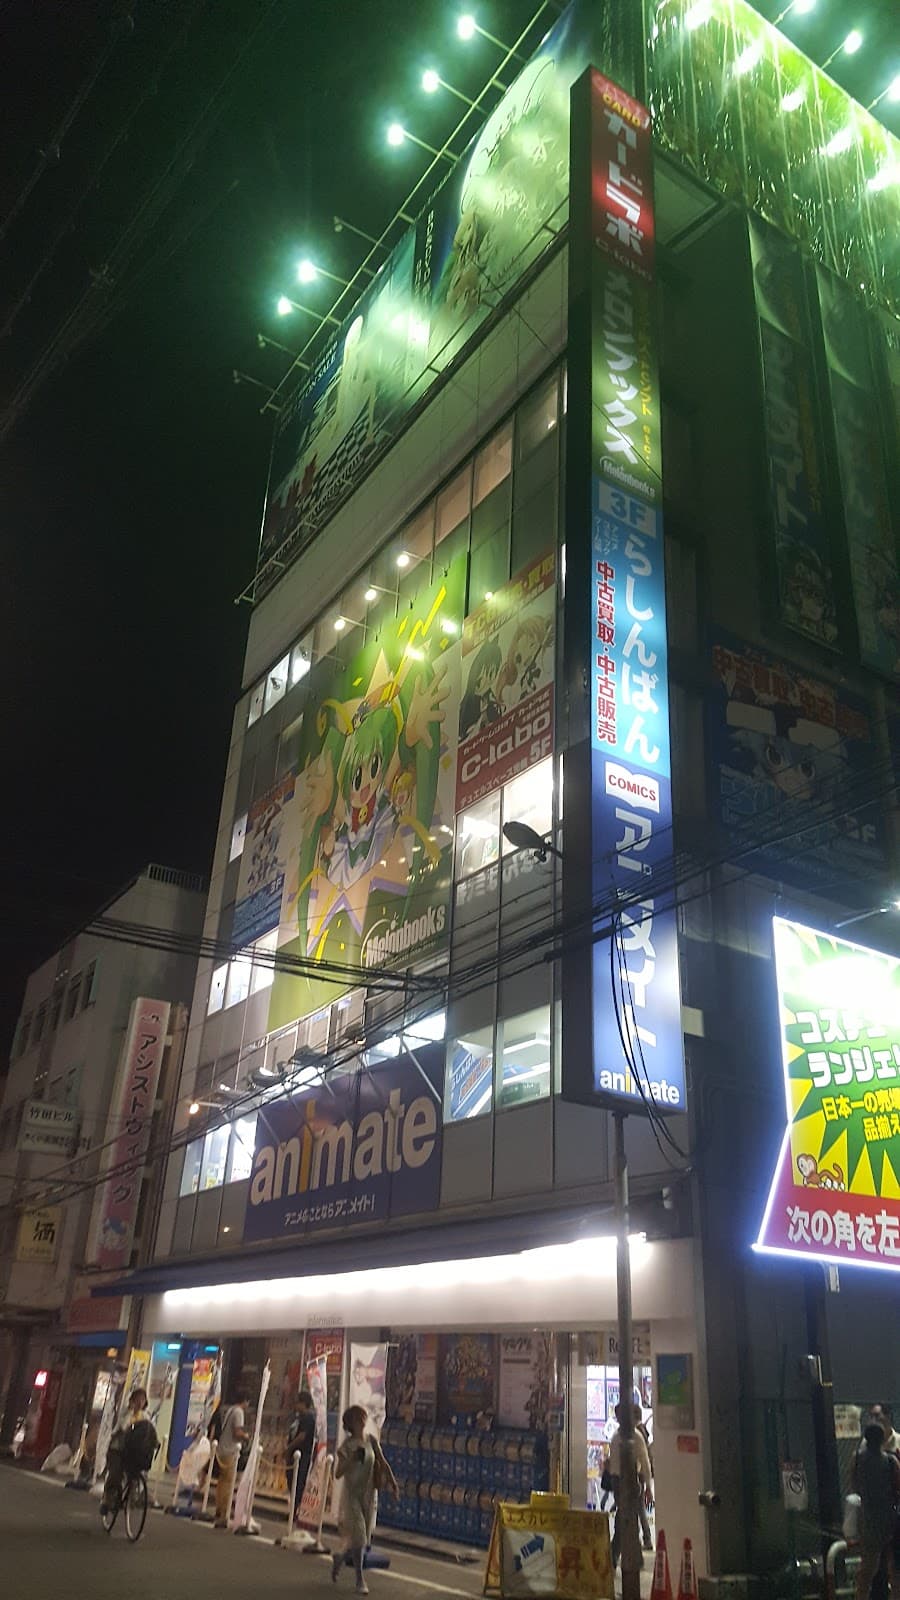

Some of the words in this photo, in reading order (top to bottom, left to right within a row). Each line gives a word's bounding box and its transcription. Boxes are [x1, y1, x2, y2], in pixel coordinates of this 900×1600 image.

[603, 108, 643, 256] カードラボ
[610, 490, 648, 527] 3F
[622, 534, 660, 764] らしんばん
[461, 710, 551, 785] C-labo
[530, 735, 552, 765] 5F
[608, 773, 657, 802] COMICS
[600, 1066, 680, 1105] animate
[251, 1087, 437, 1207] animate
